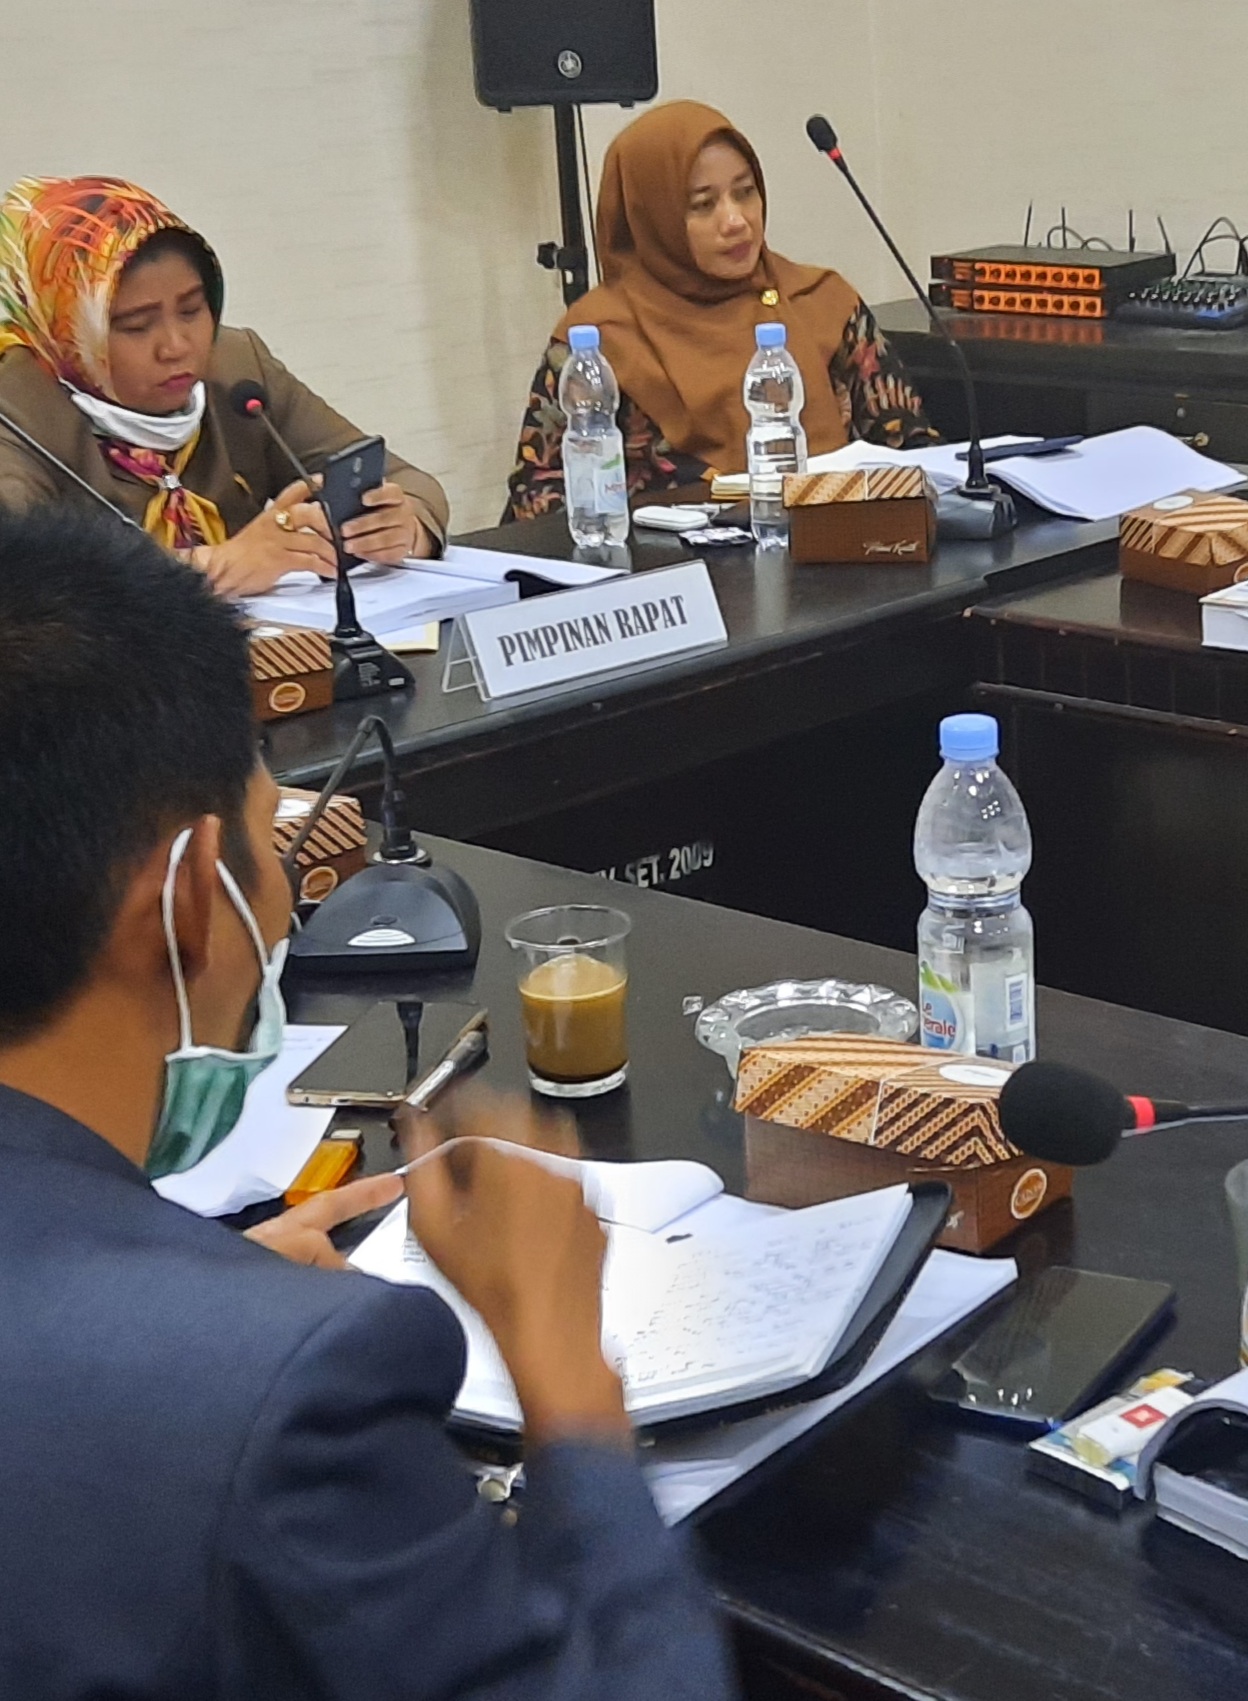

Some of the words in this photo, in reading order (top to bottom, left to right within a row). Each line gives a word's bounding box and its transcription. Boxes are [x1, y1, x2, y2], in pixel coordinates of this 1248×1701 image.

[496, 611, 613, 667] PIMPINAN
[612, 594, 689, 640] RAPAT
[668, 840, 714, 880] 2009
